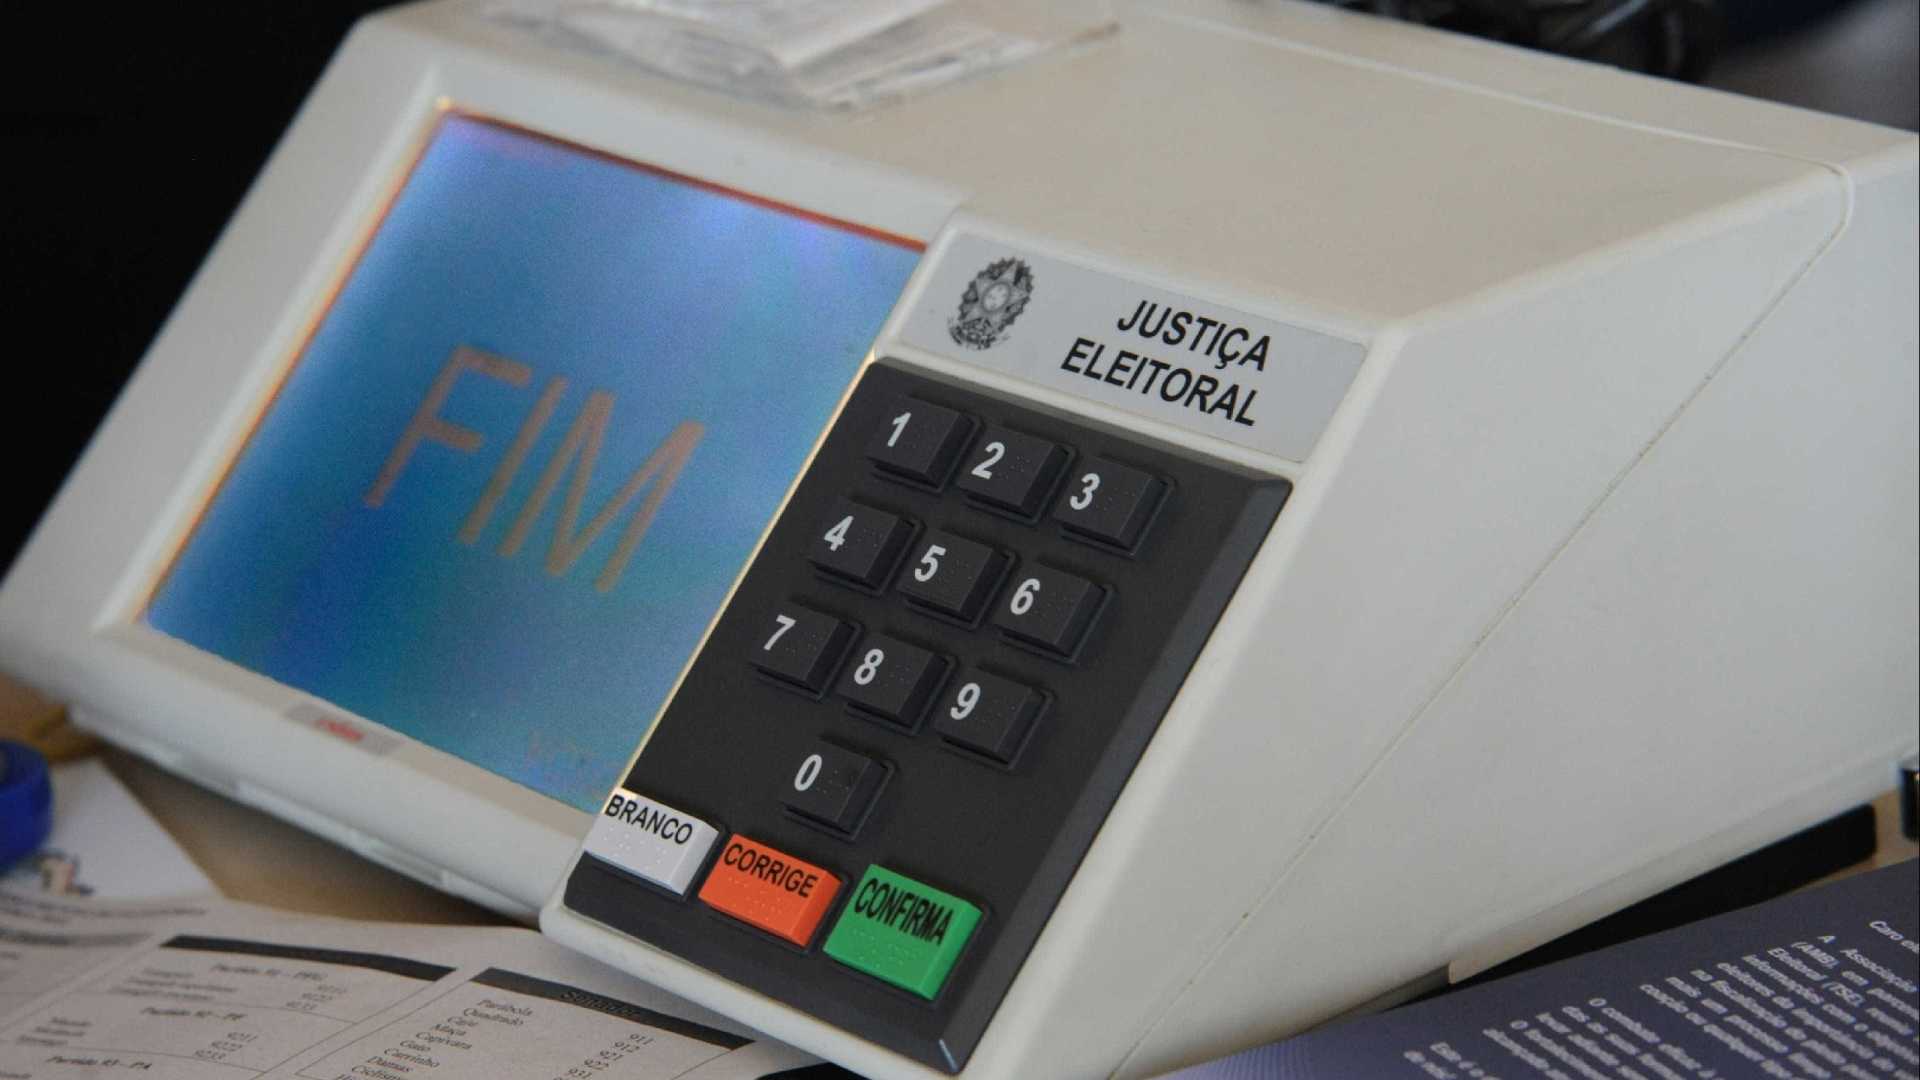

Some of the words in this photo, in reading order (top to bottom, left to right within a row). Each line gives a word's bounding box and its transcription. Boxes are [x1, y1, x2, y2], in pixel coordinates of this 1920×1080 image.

[1117, 300, 1271, 372] JUSTIÇA
[1060, 337, 1259, 427] ELEITORAL
[363, 344, 705, 591] FIM
[887, 412, 911, 447] 1
[971, 442, 1005, 479] 2
[1070, 473, 1100, 510] 3
[824, 515, 854, 551] 4
[914, 544, 946, 582] 5
[1010, 578, 1040, 616] 6
[764, 614, 797, 650] 7
[854, 649, 885, 685] 8
[950, 683, 981, 720] 9
[794, 754, 822, 791] 0
[604, 794, 693, 845] BRANCO
[723, 843, 818, 899] CORRIGE
[853, 878, 955, 946] CONFIRMA
[1816, 935, 1836, 943] A
[1869, 920, 1904, 940] Caro
[1588, 997, 1608, 1008] O
